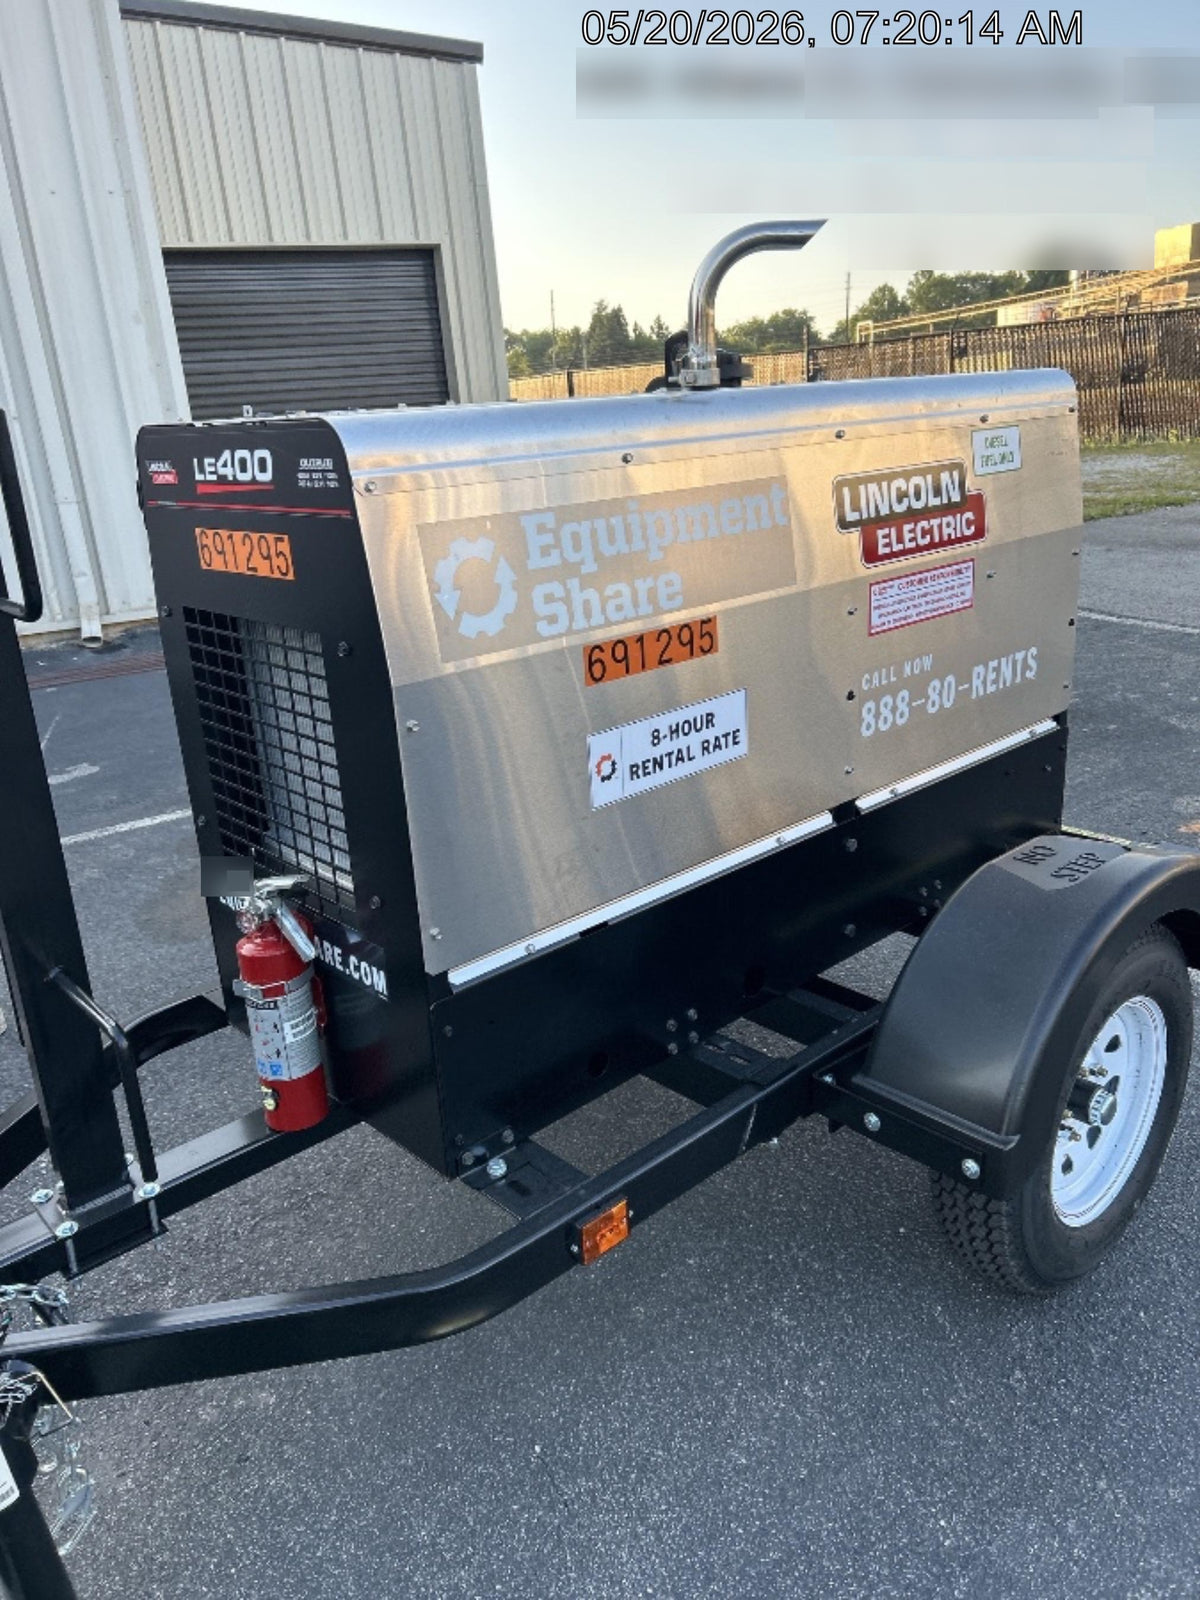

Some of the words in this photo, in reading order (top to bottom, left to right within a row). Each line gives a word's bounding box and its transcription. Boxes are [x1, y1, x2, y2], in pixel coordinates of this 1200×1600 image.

[193, 449, 273, 482] LE400
[842, 469, 961, 522] LINCOLN
[200, 529, 290, 578] 691295
[519, 482, 790, 574] Equipment
[876, 511, 976, 556] ELECTRIC
[531, 570, 684, 638] Share
[587, 617, 714, 683] 691295
[862, 666, 897, 690] CALL
[903, 654, 933, 678] NOW
[860, 646, 1038, 737] 888-80-RENTS
[629, 745, 696, 781] RENTAL
[701, 728, 741, 757] RATE
[650, 712, 716, 747] 8-HOUR
[1012, 845, 1057, 866] NO
[1050, 853, 1106, 882] STEP
[314, 935, 388, 996] ARE.COM
